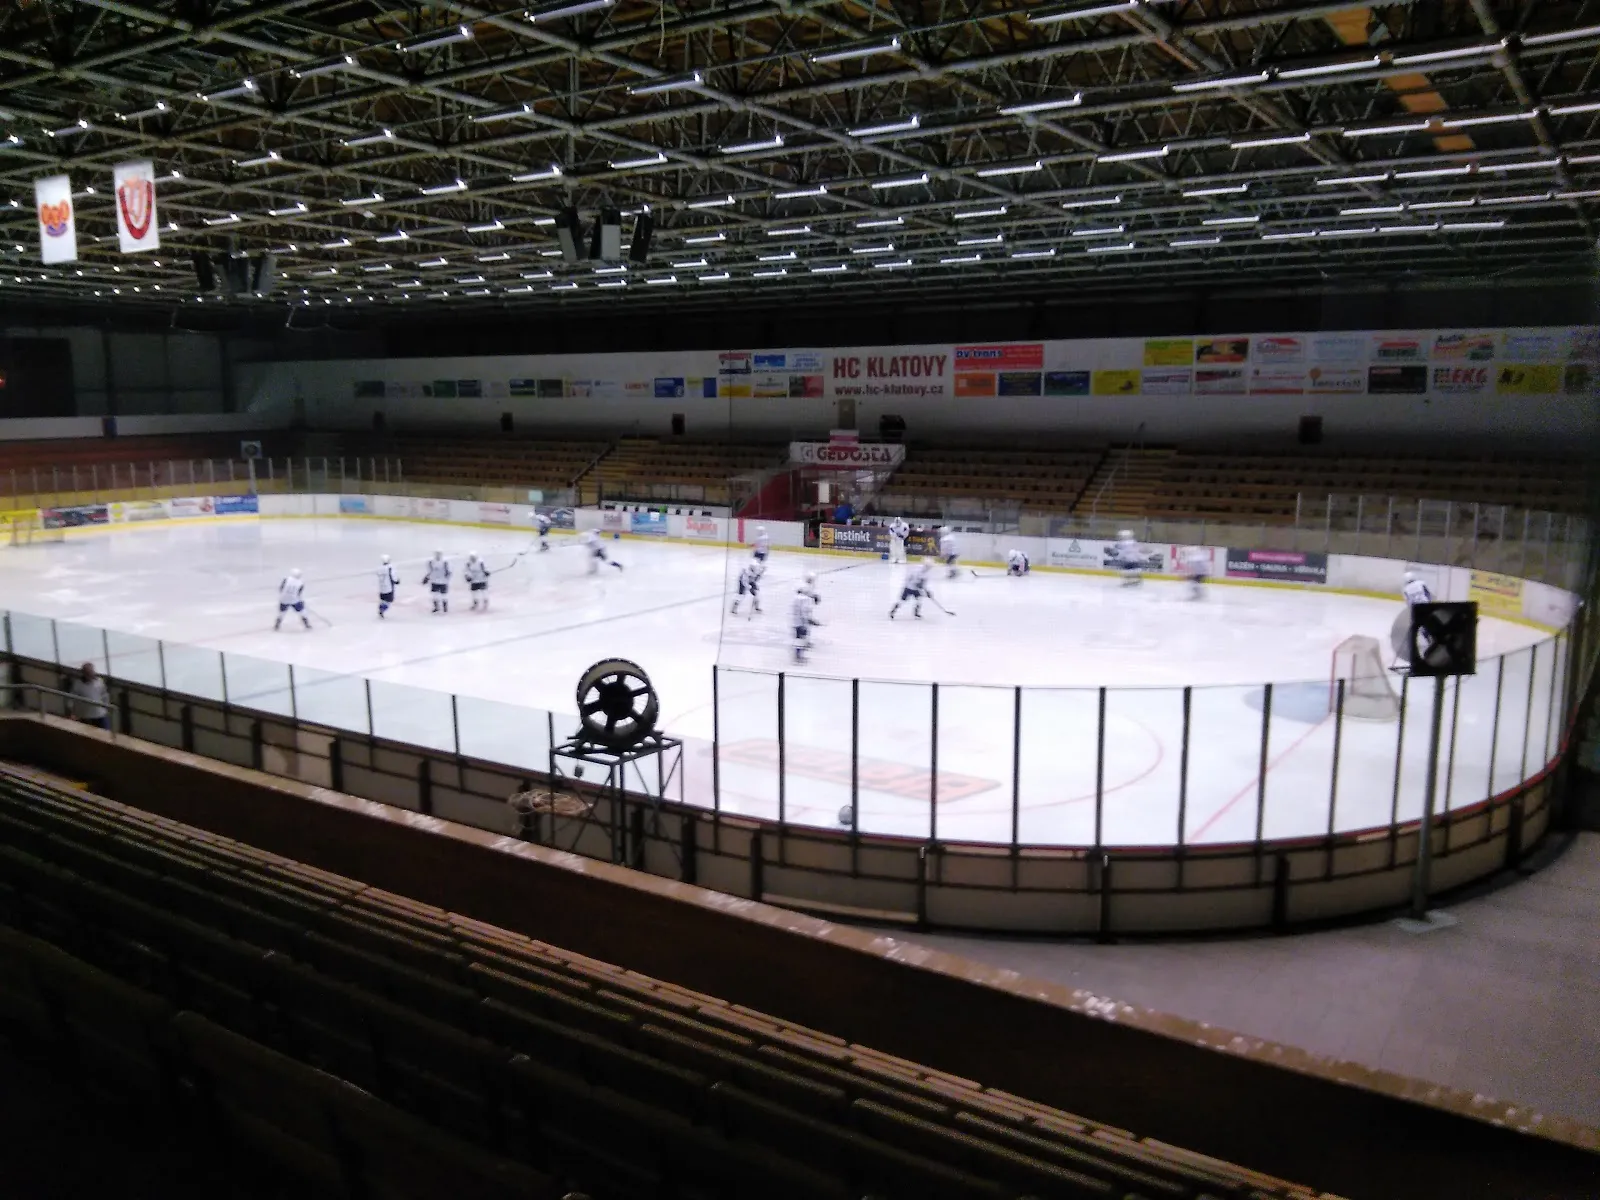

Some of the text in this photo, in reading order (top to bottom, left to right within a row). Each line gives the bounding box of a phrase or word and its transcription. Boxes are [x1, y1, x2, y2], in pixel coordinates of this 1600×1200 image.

[833, 357, 861, 379] HC
[867, 354, 947, 378] KLATOVY
[835, 383, 944, 397] www.hc-klatovy.cz
[834, 528, 871, 543] instinkt
